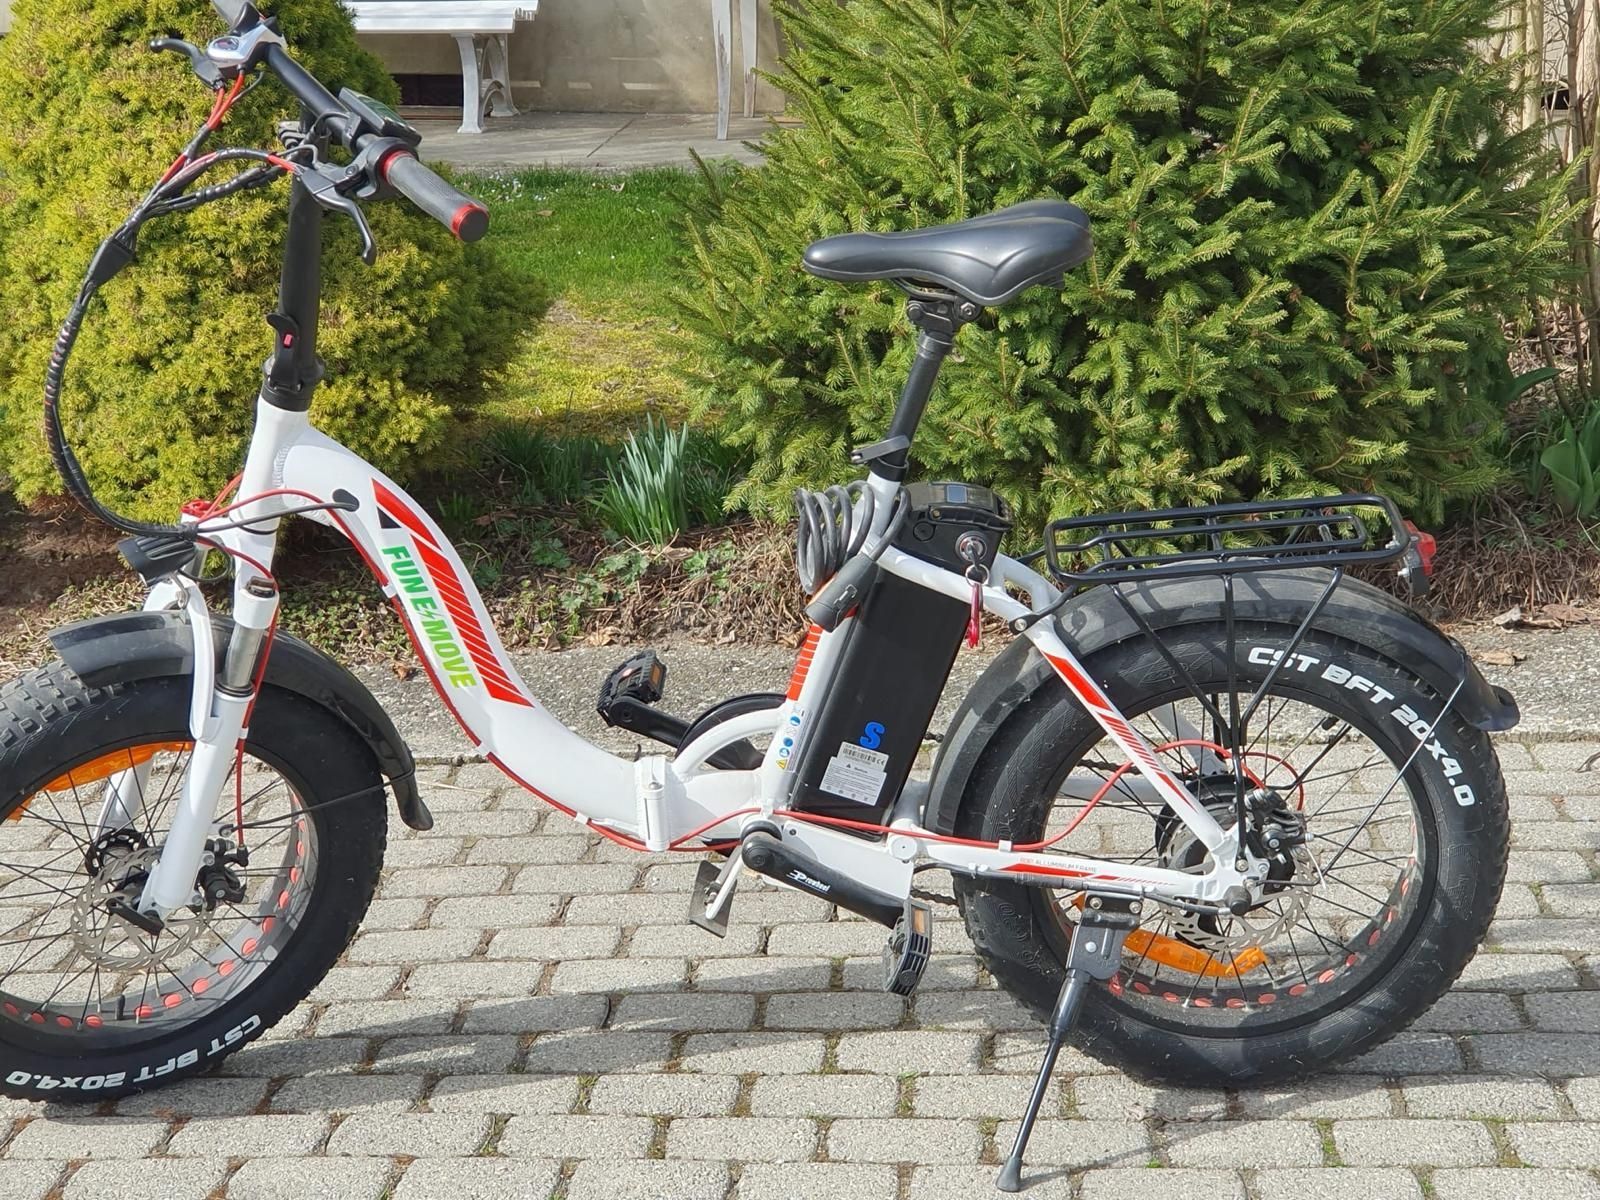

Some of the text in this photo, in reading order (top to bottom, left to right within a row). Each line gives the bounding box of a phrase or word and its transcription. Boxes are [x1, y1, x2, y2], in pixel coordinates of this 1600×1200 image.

[1247, 646, 1321, 673] CST
[1320, 663, 1395, 704] BFT
[859, 721, 886, 750] S
[207, 1014, 261, 1056] CST
[132, 1049, 198, 1082] BFT
